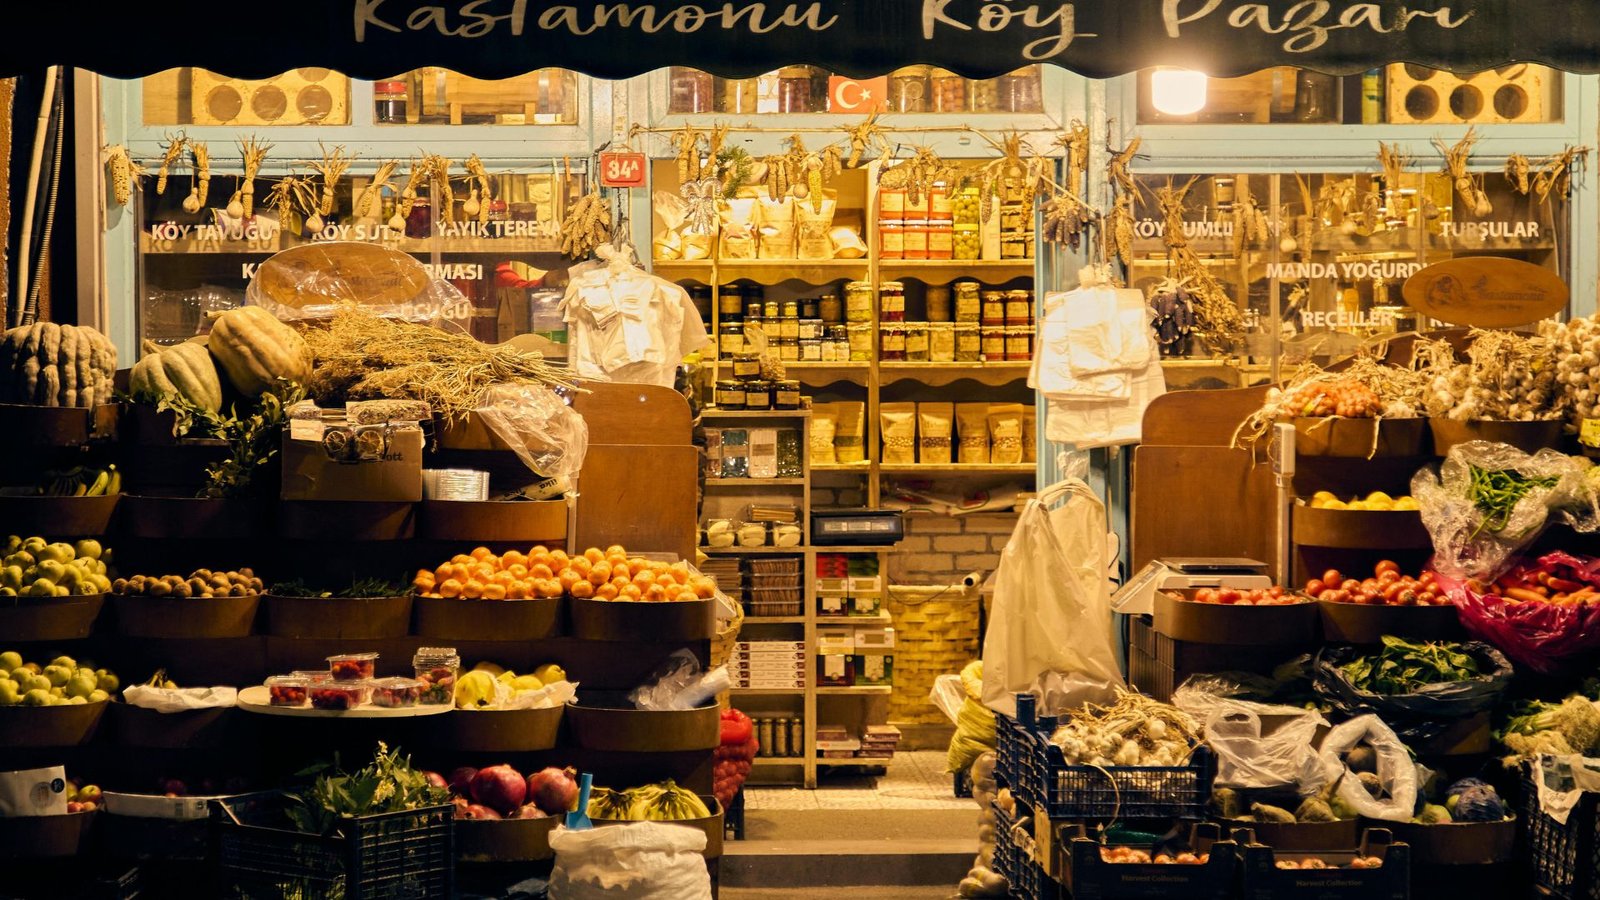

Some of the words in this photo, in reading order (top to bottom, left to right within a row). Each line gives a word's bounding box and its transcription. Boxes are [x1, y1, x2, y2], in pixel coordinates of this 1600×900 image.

[354, 0, 839, 42] Kastamonu
[922, 0, 1098, 60] Köy
[1162, 0, 1478, 53] Pazarı
[151, 221, 190, 241] KÖY
[193, 221, 273, 241] TAVUĞU
[1439, 221, 1540, 241] TURŞULAR
[1265, 263, 1339, 279] MANDA
[1340, 260, 1437, 279] YOĞURD
[1301, 311, 1393, 330] REÇELLER
